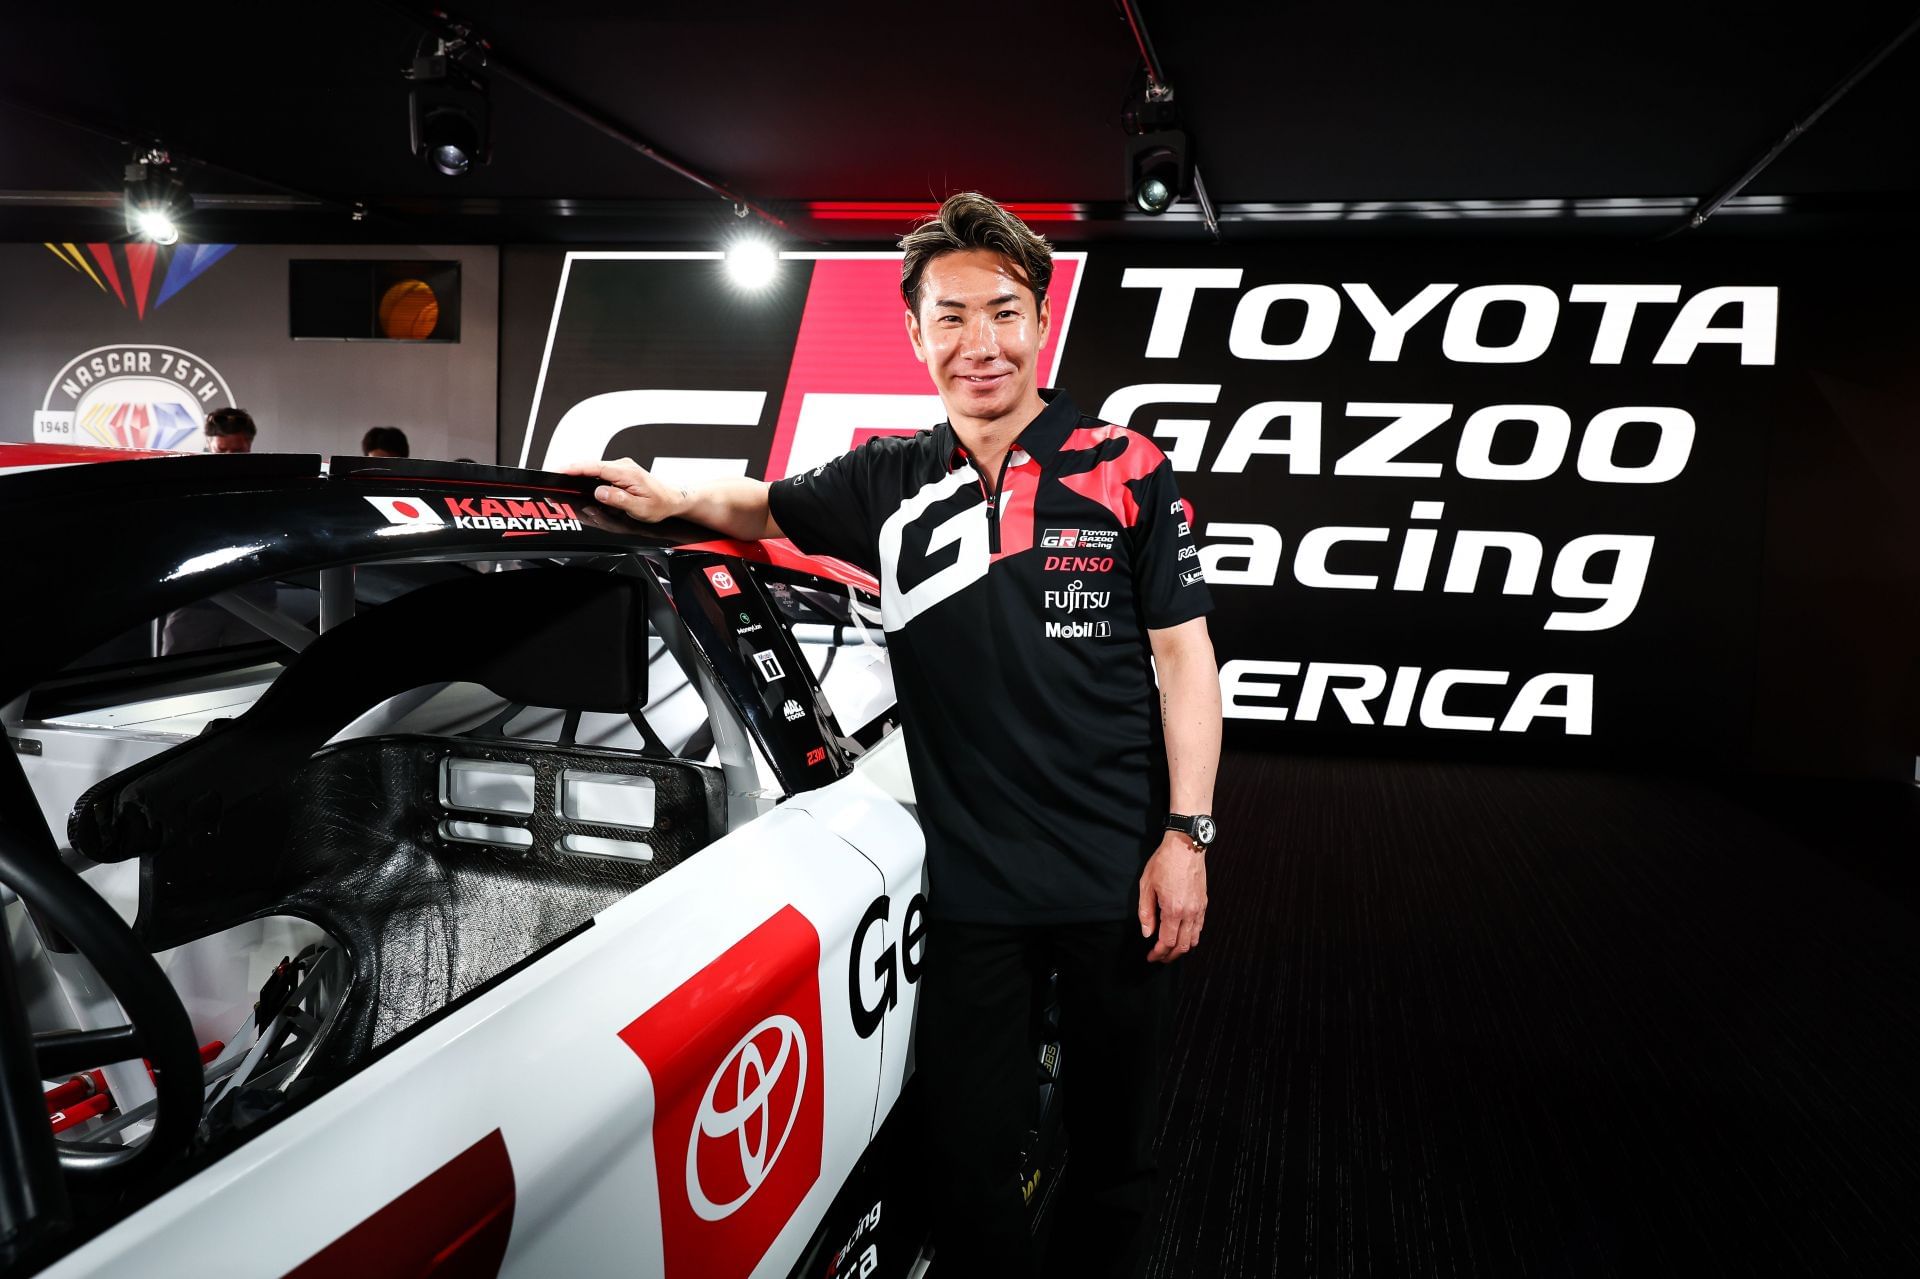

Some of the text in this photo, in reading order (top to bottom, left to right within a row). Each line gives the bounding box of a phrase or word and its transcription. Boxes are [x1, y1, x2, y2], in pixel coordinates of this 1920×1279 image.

[1121, 268, 1778, 365] TOYOTA
[61, 352, 219, 402] NASCAR 75TH
[40, 421, 69, 434] 1948
[1098, 384, 1696, 483] GAZOO
[444, 497, 578, 519] KAMUI
[454, 516, 583, 531] KOBAYASHI
[1081, 529, 1118, 537] TOYOTA
[1044, 557, 1114, 572] DENSO
[1182, 500, 1655, 631] acing
[1045, 590, 1110, 613] FUJITSU
[1045, 622, 1093, 638] Mobil
[1217, 658, 1593, 735] ERICA
[786, 710, 806, 722] TOOLS
